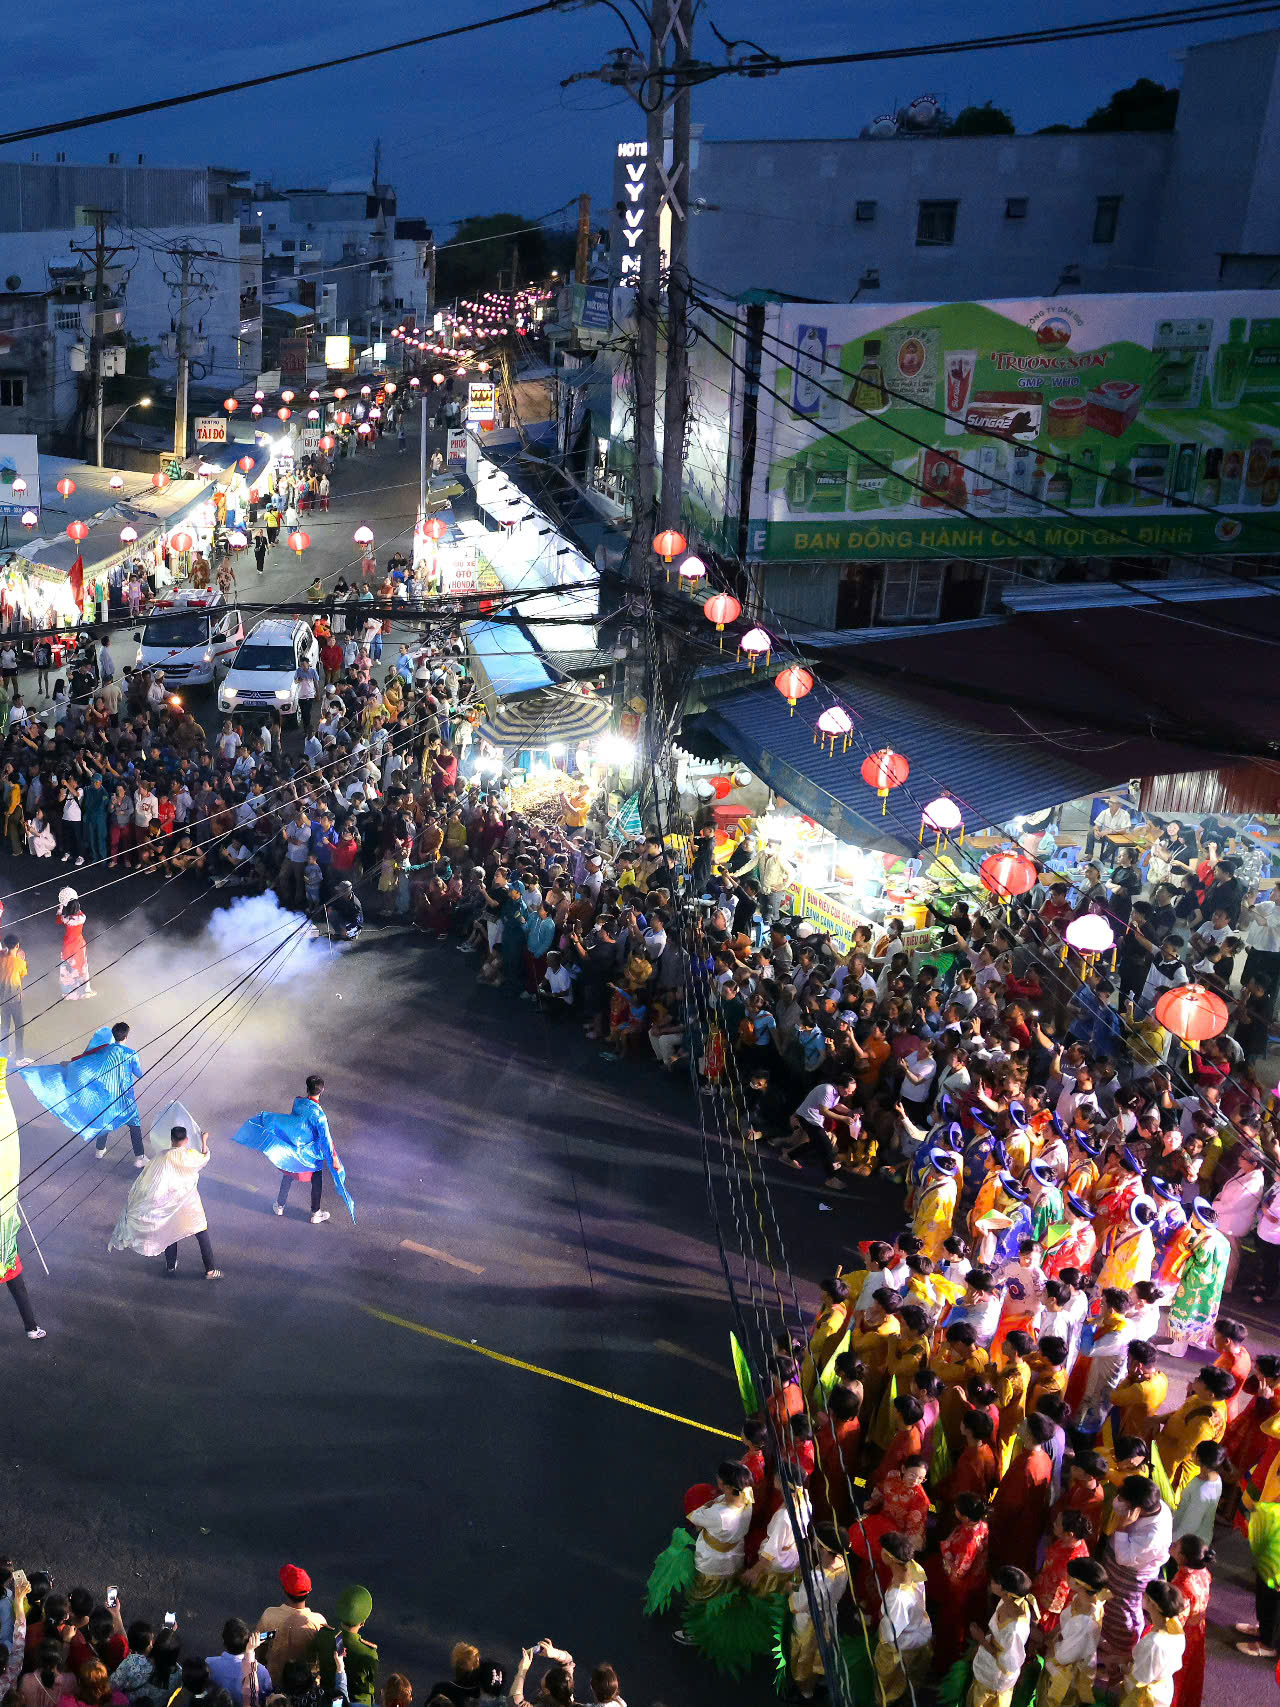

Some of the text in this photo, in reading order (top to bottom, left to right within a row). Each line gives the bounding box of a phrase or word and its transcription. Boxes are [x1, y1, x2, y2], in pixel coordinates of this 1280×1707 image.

[618, 142, 648, 157] HOTE
[1018, 376, 1080, 388] GMP WHO
[197, 425, 212, 439] TÀI
[921, 526, 983, 547] HÀNH
[1045, 527, 1086, 551] MỌI
[451, 580, 476, 589] HONDA
[820, 915, 835, 932] CANH
[844, 930, 852, 942] HE
